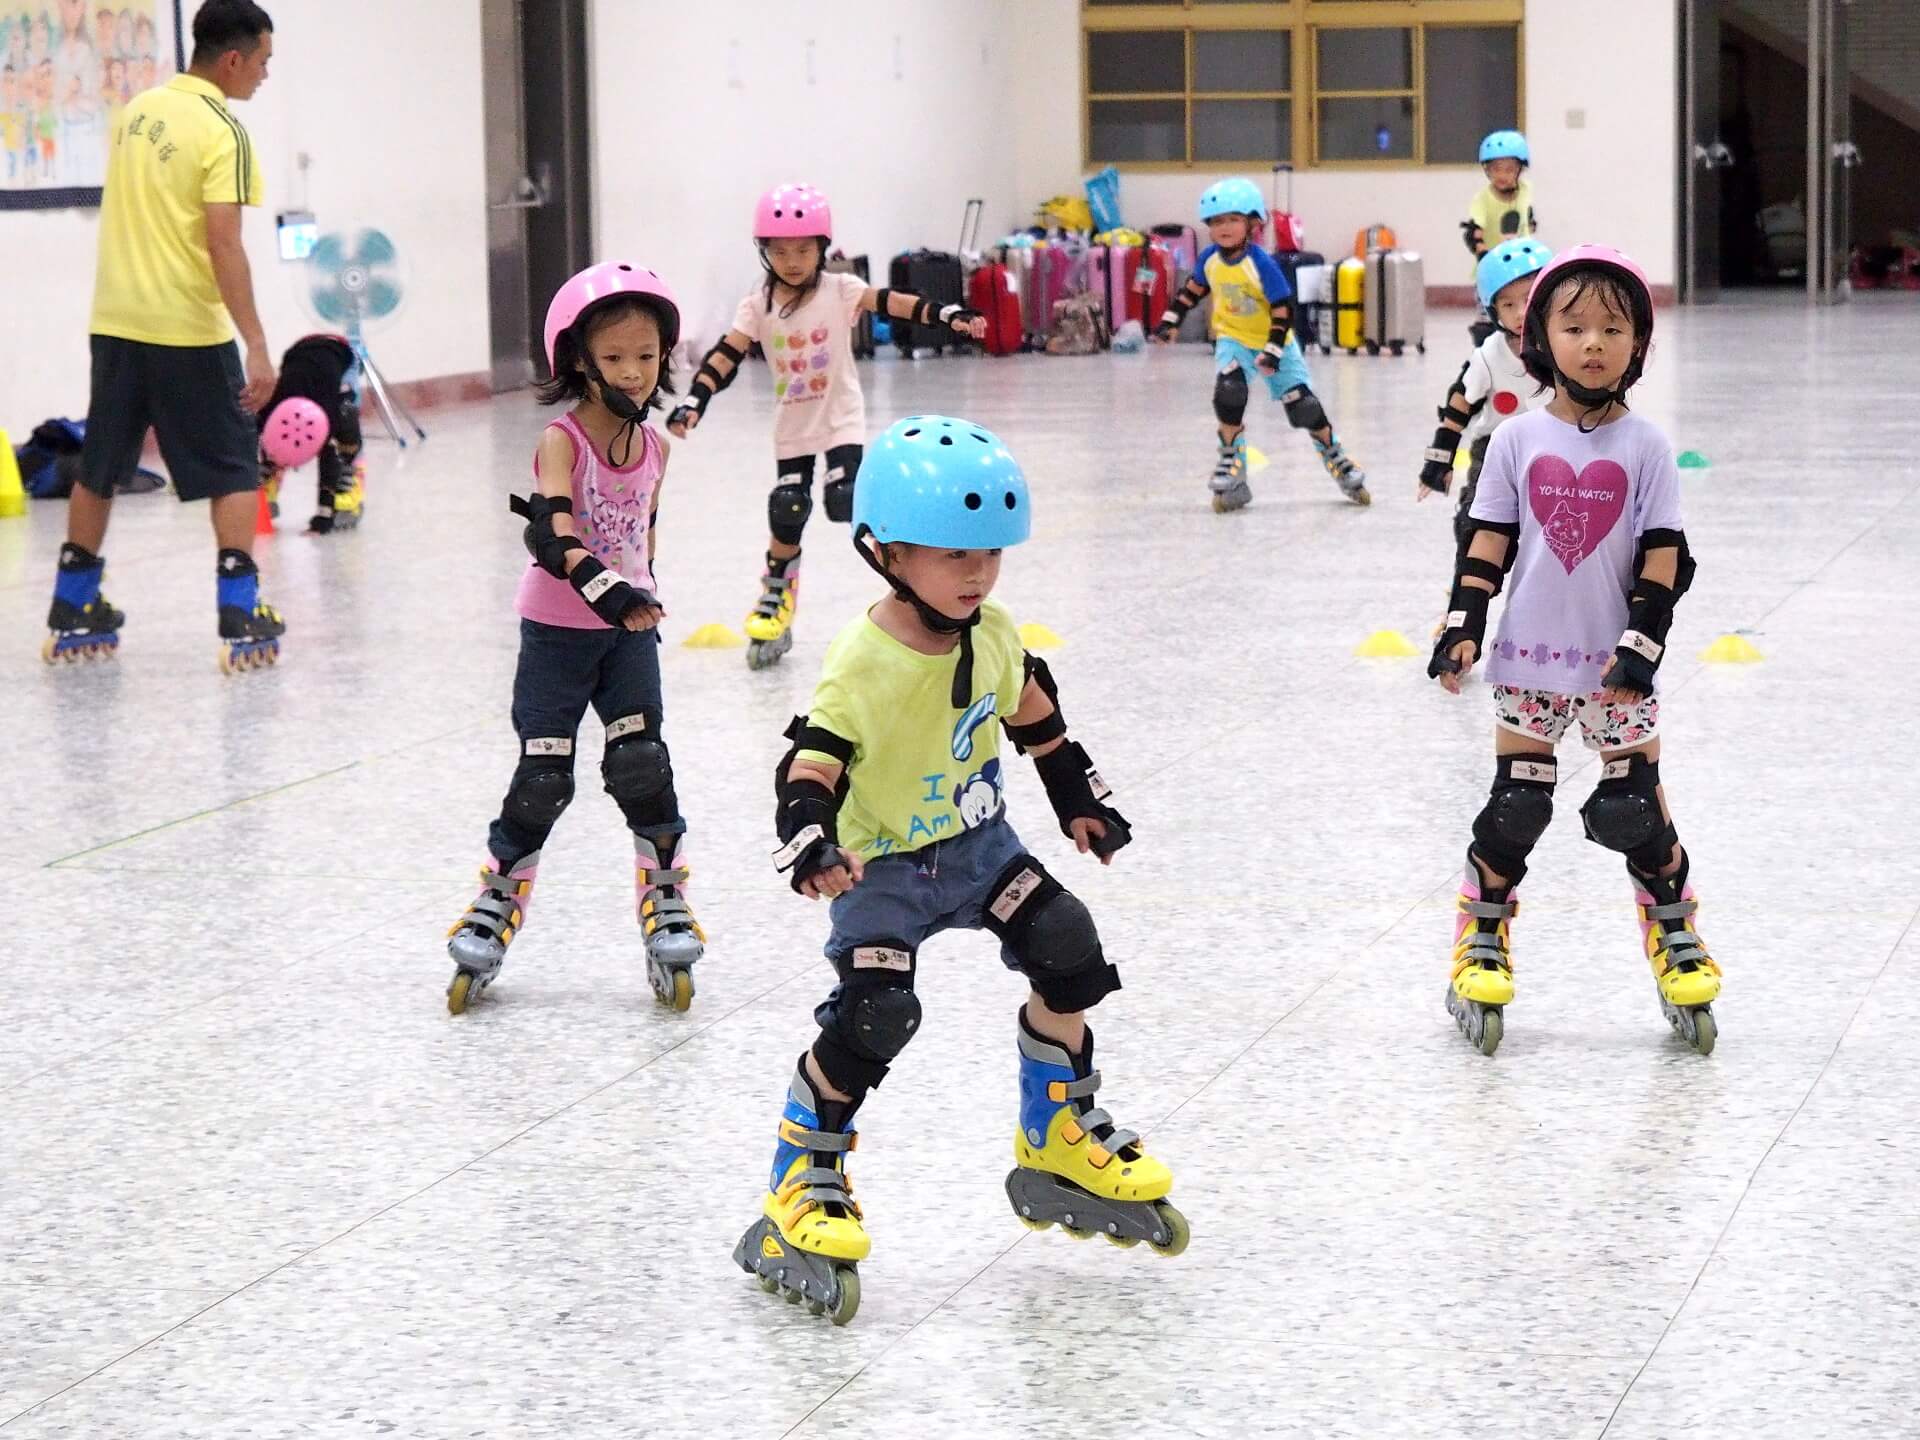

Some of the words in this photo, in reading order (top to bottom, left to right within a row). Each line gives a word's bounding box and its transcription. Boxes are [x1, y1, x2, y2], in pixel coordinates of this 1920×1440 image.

[1539, 485, 1576, 498] YO-KAI
[1578, 489, 1614, 502] WATCH
[922, 773, 945, 802] I
[908, 813, 951, 843] Am
